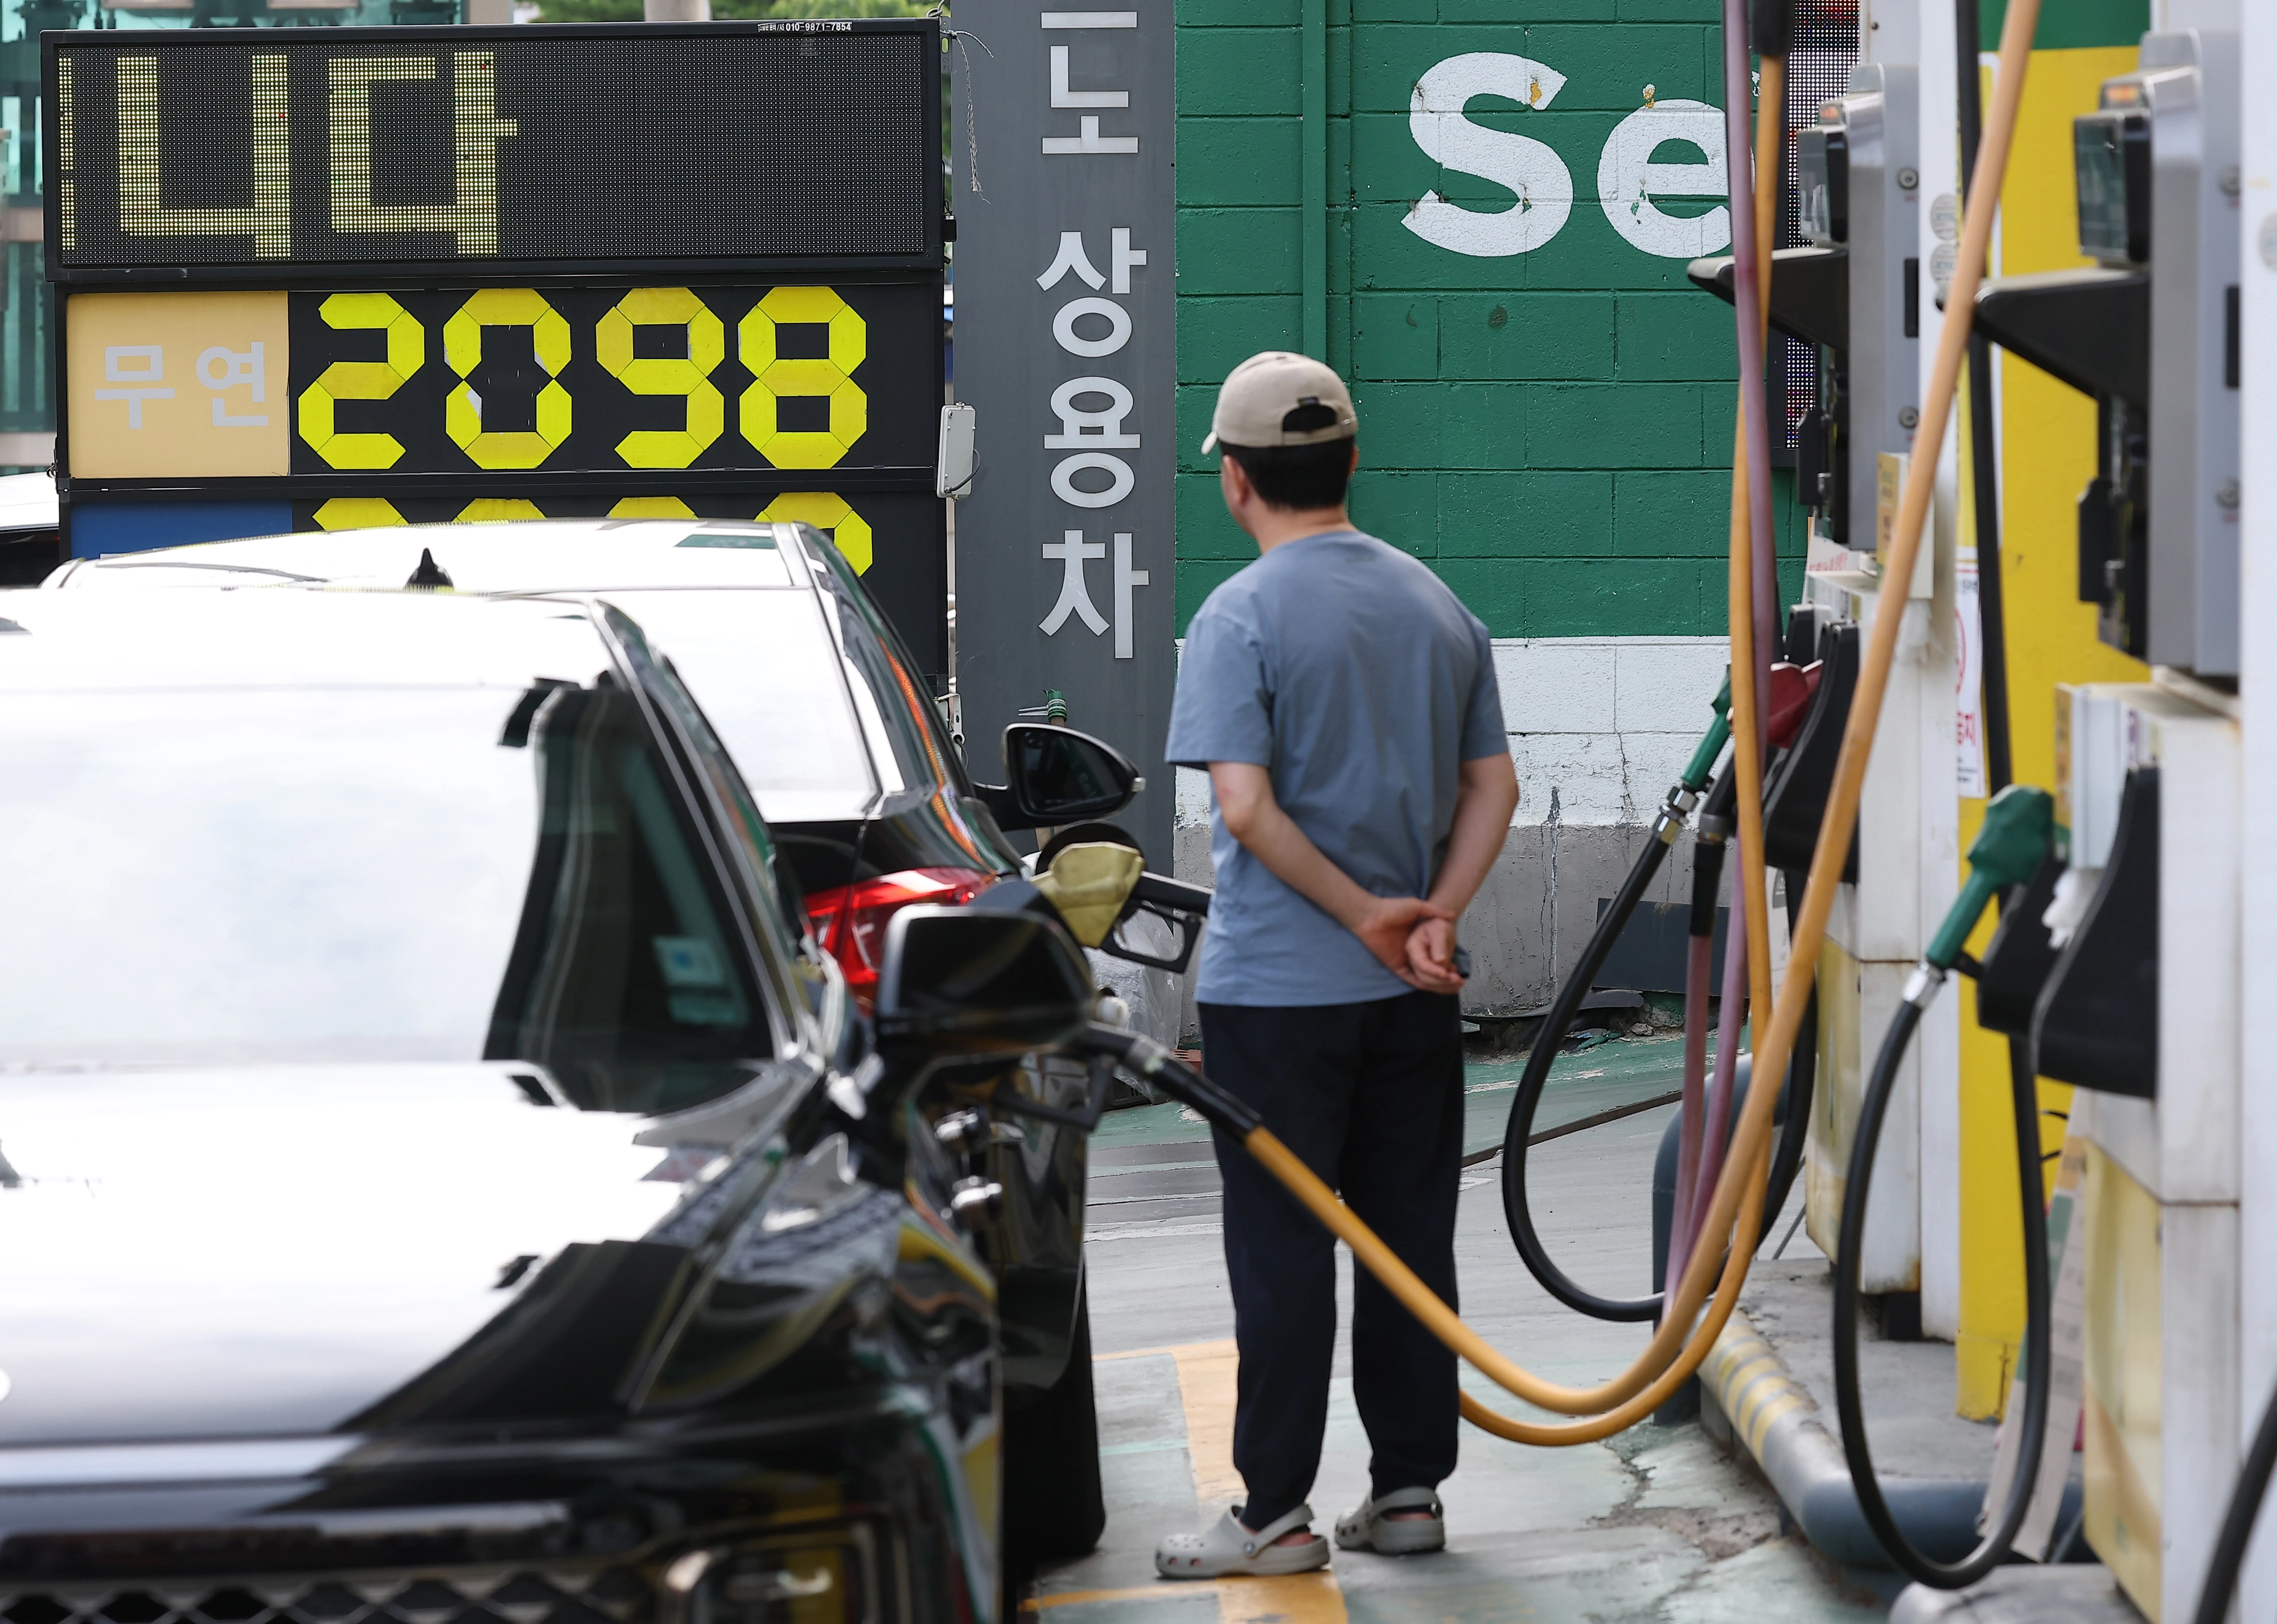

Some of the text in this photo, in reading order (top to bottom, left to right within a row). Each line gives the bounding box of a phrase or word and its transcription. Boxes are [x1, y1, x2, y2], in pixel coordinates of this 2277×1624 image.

[786, 23, 852, 31] 010-9871-7854
[59, 52, 517, 257] 니다
[94, 342, 269, 430] 무연
[298, 286, 867, 470] 2098
[1035, 11, 1149, 659] 노 상용차
